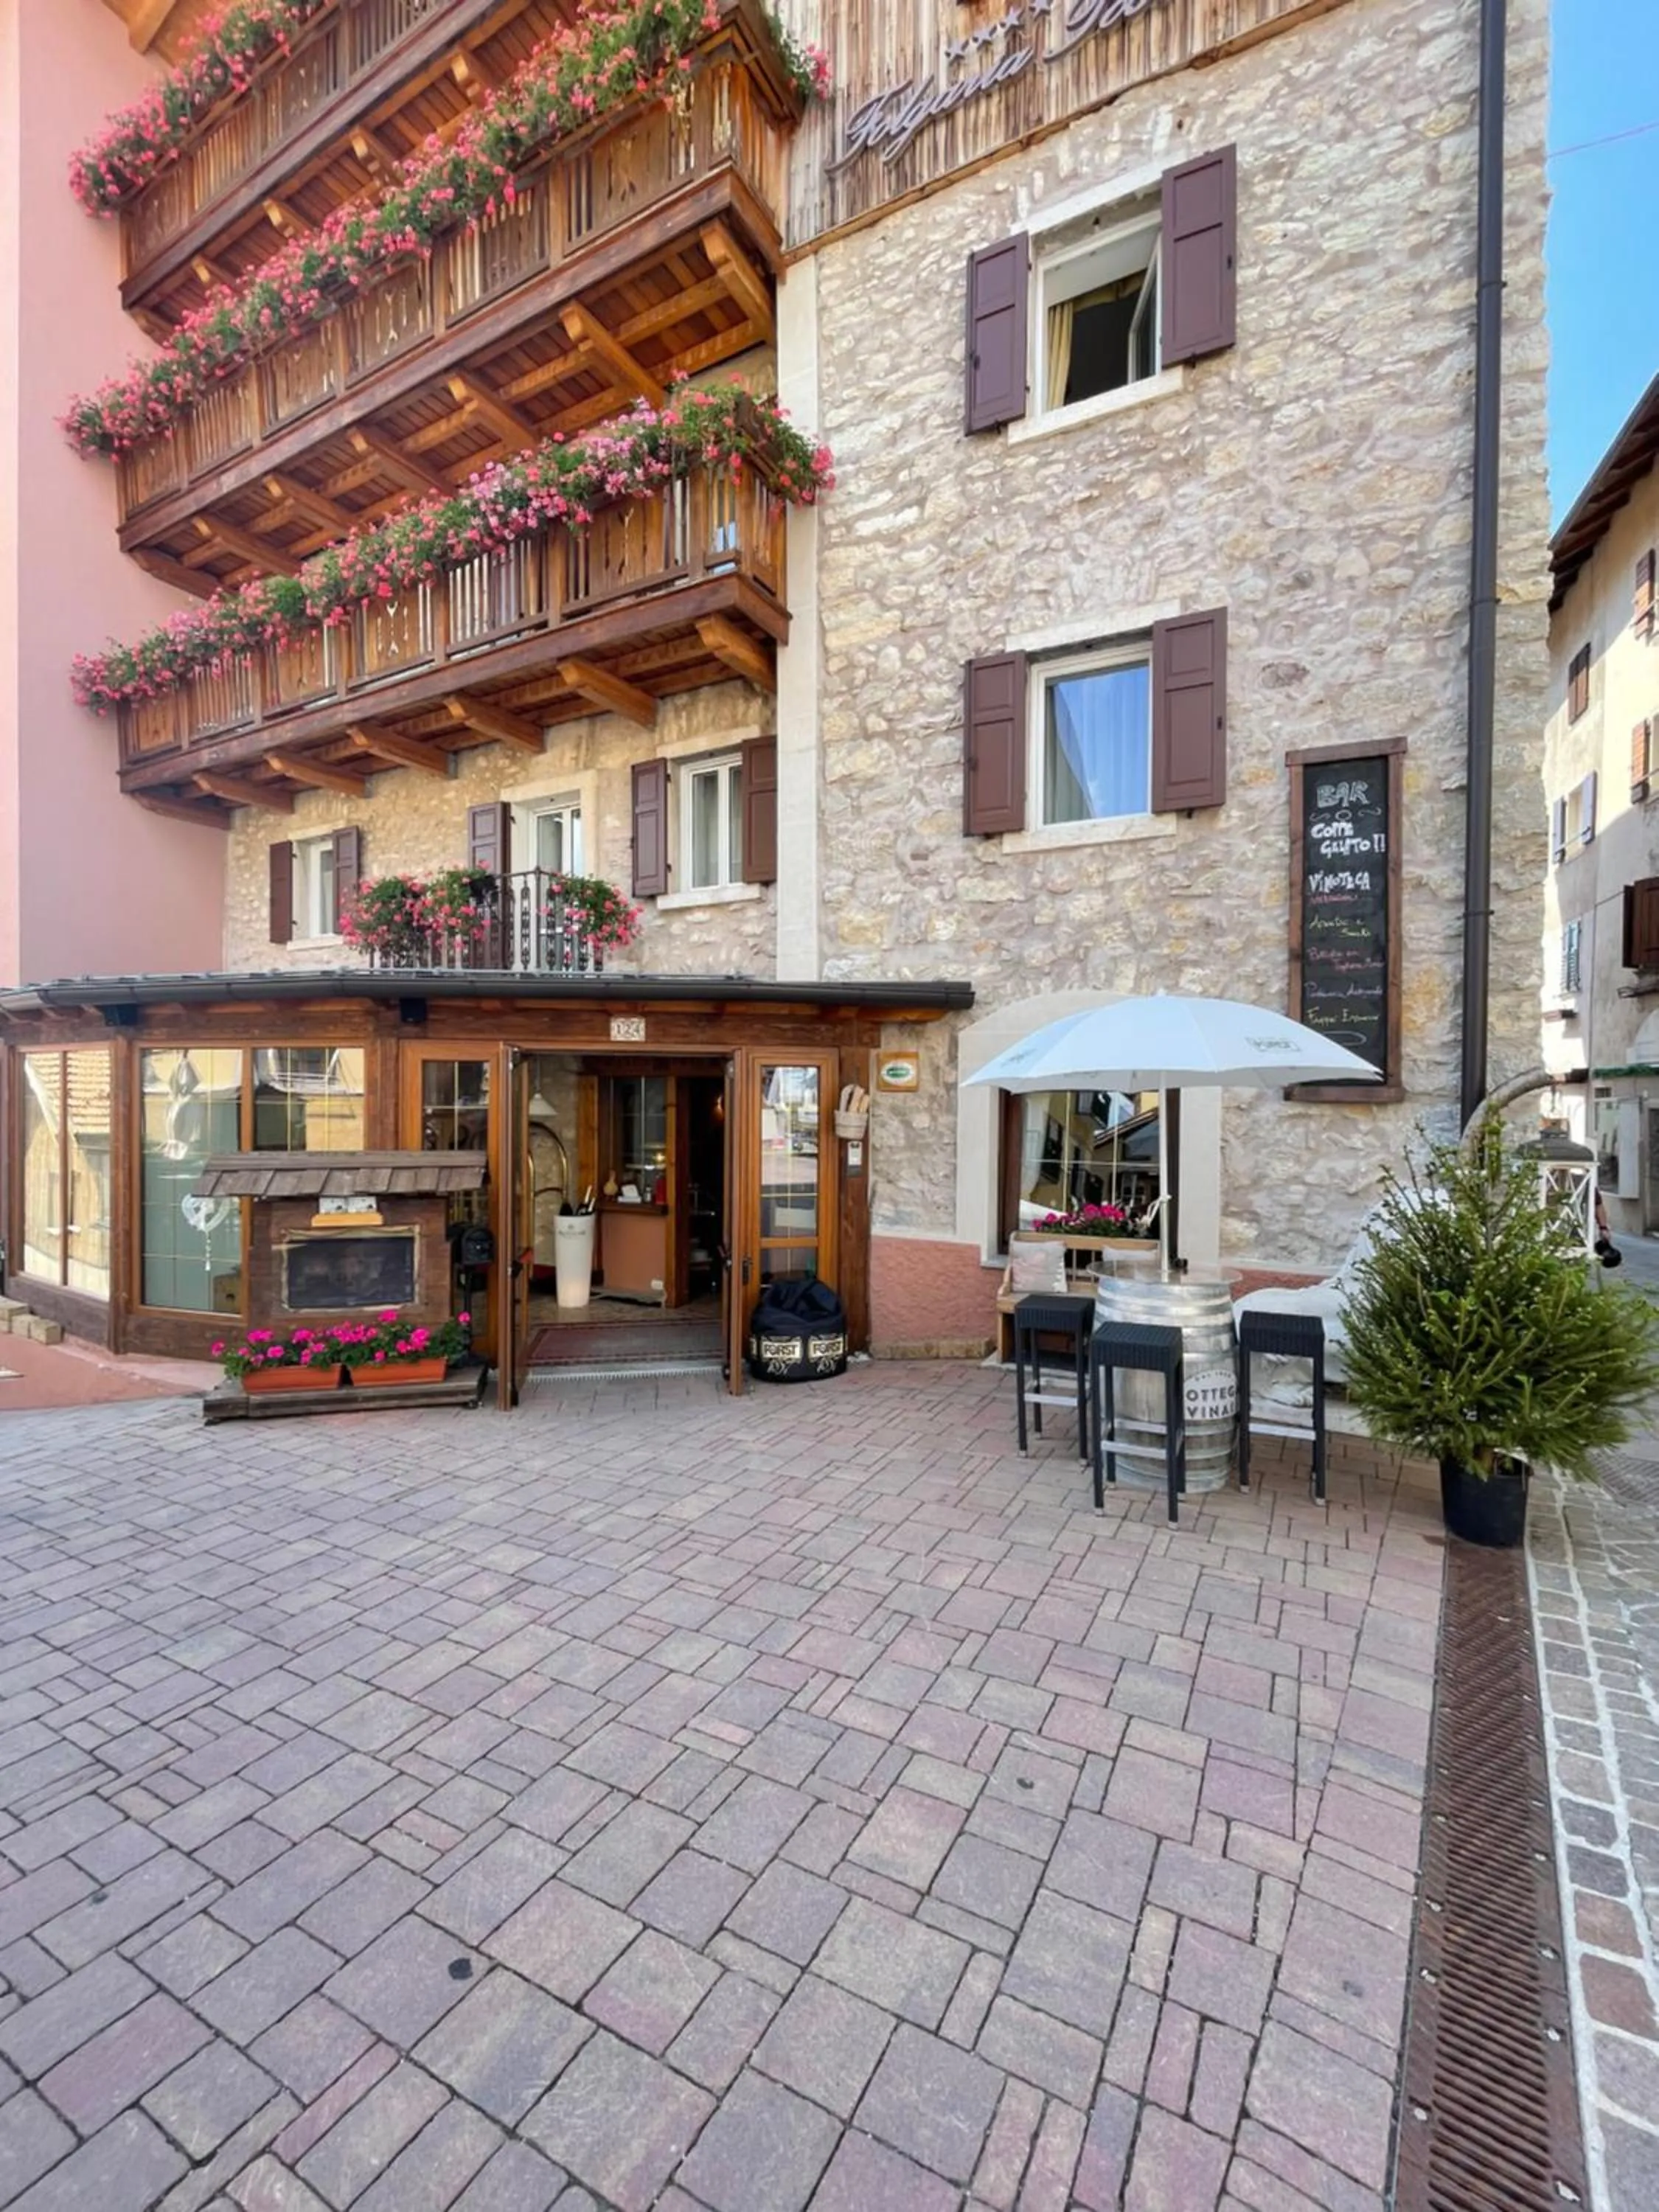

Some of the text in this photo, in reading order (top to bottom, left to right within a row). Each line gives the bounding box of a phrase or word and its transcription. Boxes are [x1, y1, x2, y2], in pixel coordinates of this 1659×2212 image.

[1316, 781, 1370, 808] BAR
[1308, 869, 1371, 894] VINOTECA
[764, 1343, 797, 1355] FORST
[1186, 1385, 1235, 1402] OTTEG
